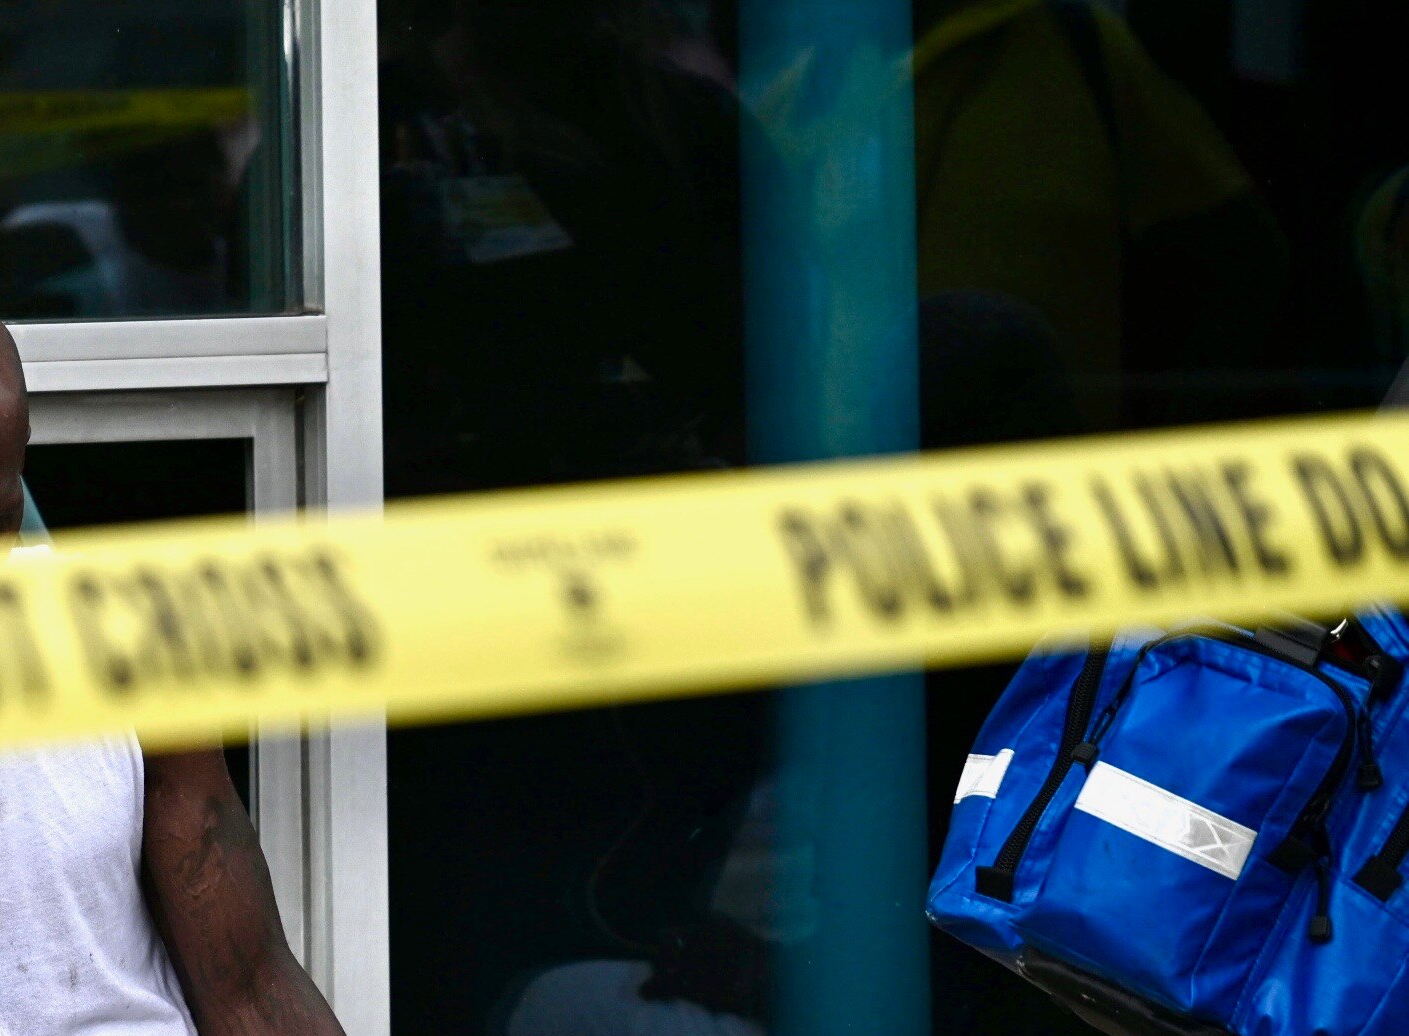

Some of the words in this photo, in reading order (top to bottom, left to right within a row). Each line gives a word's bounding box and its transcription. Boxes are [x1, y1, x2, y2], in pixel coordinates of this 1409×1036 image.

[71, 550, 381, 690] CROSS
[779, 478, 1093, 634] POLICE
[1087, 456, 1291, 592] LINE
[1289, 444, 1409, 574] DO
